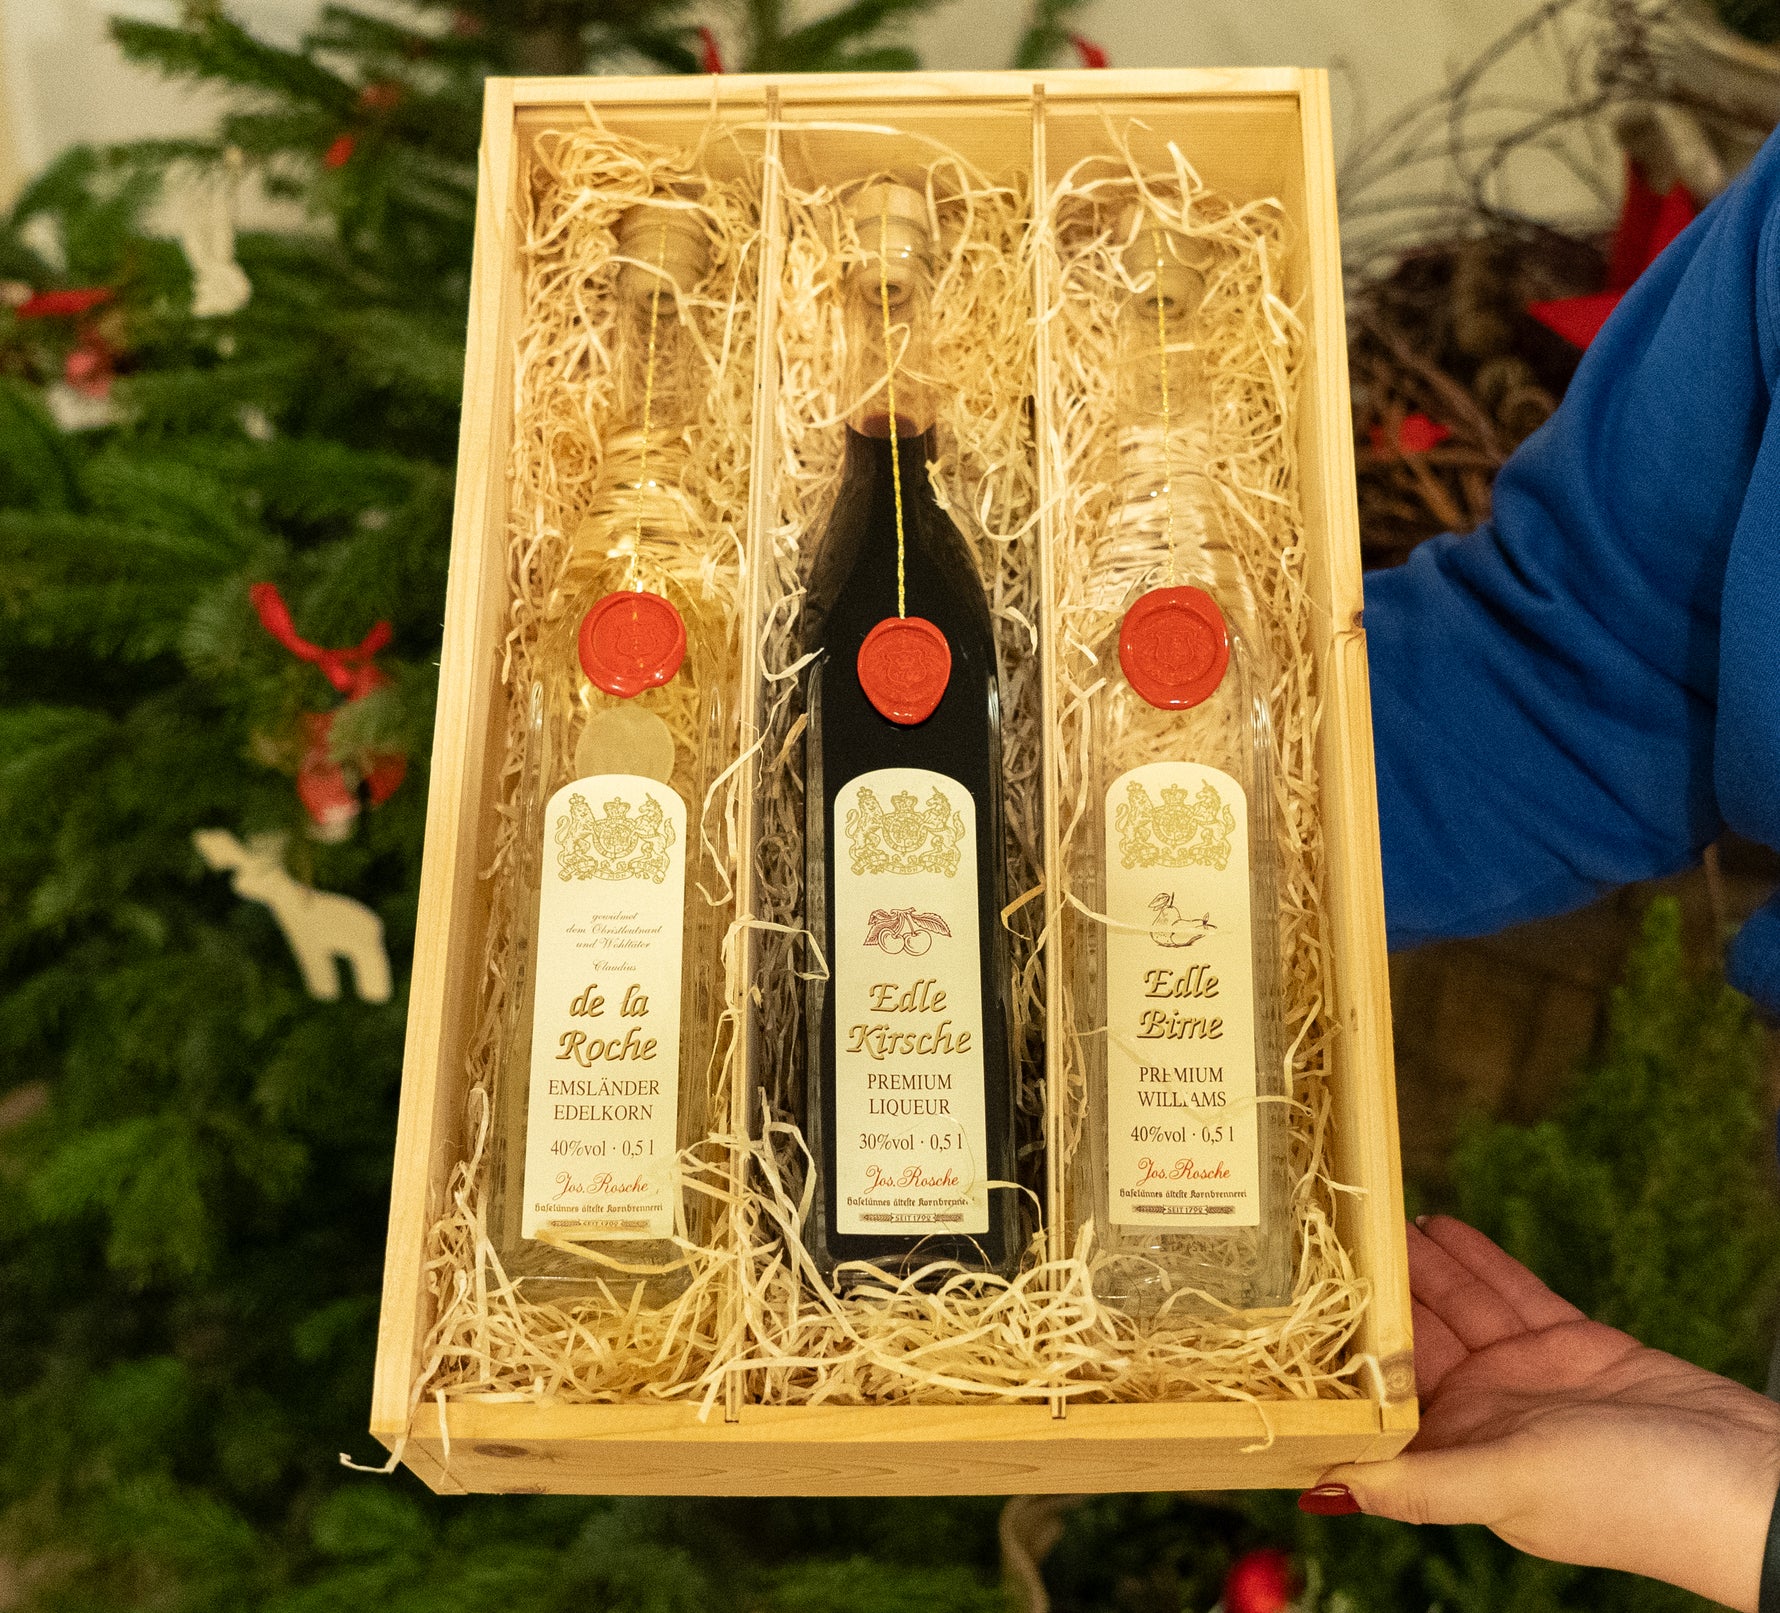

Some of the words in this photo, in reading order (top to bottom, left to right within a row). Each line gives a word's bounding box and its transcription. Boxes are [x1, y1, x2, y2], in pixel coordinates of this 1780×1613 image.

[590, 911, 639, 924] gewidmet
[566, 923, 586, 934] dem
[576, 938, 598, 948] und
[592, 960, 637, 972] Claudius
[1144, 964, 1220, 999] Edle
[569, 983, 605, 1017] de
[620, 983, 649, 1018] la
[869, 978, 947, 1014] Edle
[1136, 1007, 1224, 1040] Birne
[555, 1026, 658, 1067] Roche
[846, 1020, 972, 1060] Kirsche
[867, 1074, 952, 1090] PREMIUM
[1139, 1066, 1223, 1083] PREMIUM
[549, 1077, 660, 1096] EMSLÄNDER
[554, 1104, 653, 1121] EDELKORN
[869, 1098, 951, 1117] LIQUEUR
[859, 1133, 914, 1151] 30%vol
[930, 1133, 952, 1152] 0,5
[1131, 1126, 1186, 1143] 40%vol
[1201, 1126, 1223, 1145] 0,5
[551, 1140, 606, 1157] 40%vol
[622, 1140, 643, 1159] 0,5
[864, 1164, 896, 1194] Jos.
[897, 1165, 959, 1188] Rosche
[1136, 1157, 1168, 1186] Jos.
[1169, 1158, 1231, 1180] Rosche
[552, 1171, 585, 1201] Jos.
[586, 1172, 649, 1195] Rosche
[1190, 1188, 1247, 1198] Kornbrennerei
[606, 1203, 663, 1213] Kornbrennerei
